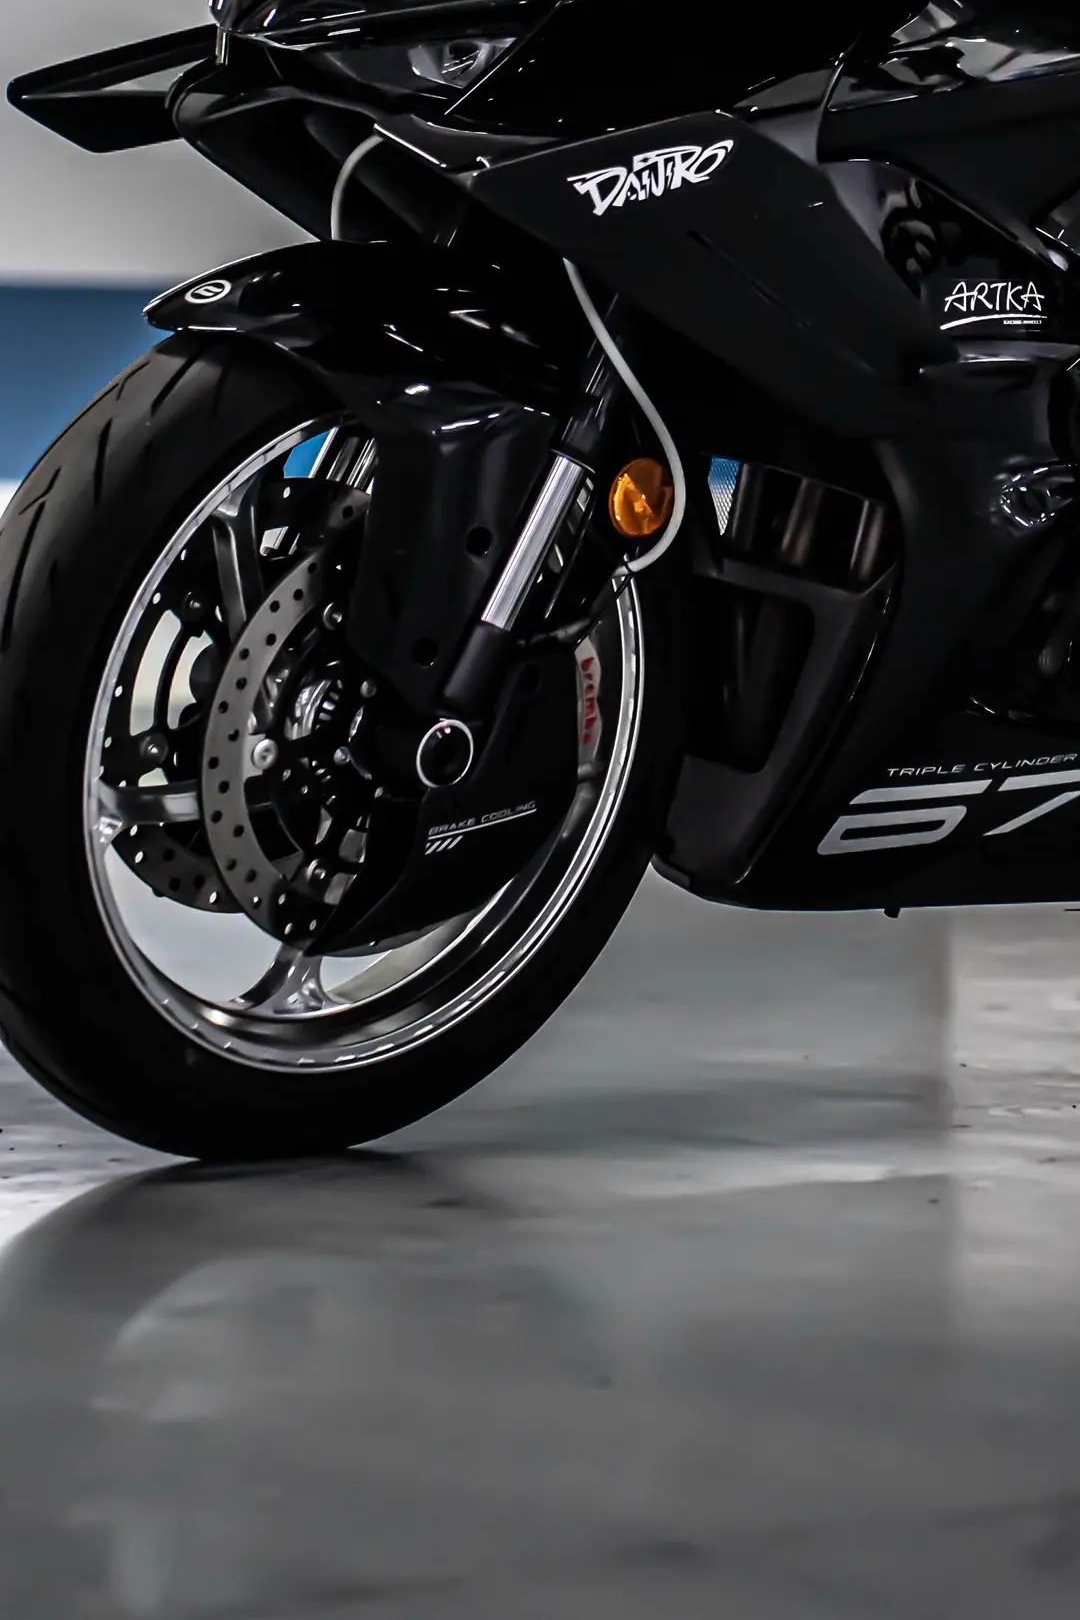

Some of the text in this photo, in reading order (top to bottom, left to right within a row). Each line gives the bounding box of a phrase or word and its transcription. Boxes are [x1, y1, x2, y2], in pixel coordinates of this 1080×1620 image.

[944, 281, 1045, 312] ARTKA
[887, 753, 1078, 777] TRIPLE CYLINDER
[428, 801, 536, 836] BRAKE COOLING
